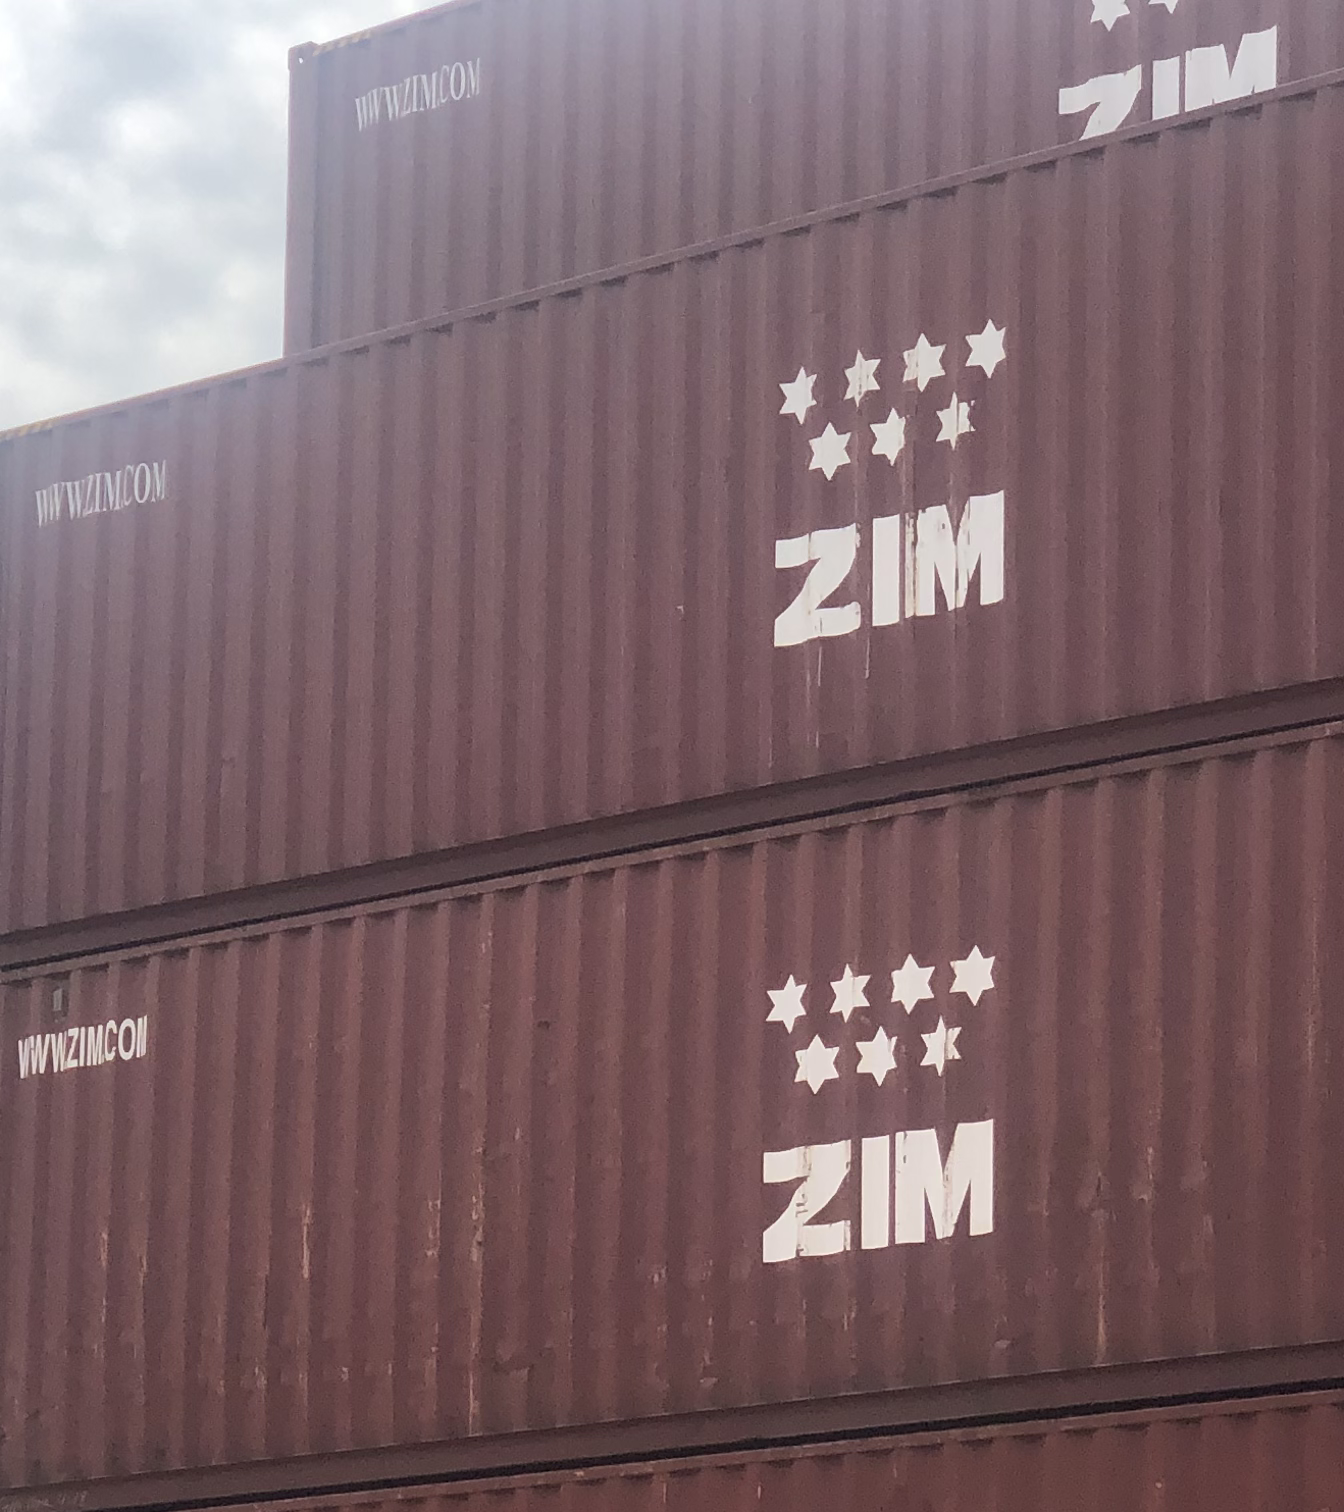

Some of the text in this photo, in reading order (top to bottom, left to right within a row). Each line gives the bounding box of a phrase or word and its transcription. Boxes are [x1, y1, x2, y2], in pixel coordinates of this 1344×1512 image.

[1059, 26, 1277, 141] ZIM
[774, 490, 1004, 647] ZIM
[763, 1119, 993, 1263] ZIM
